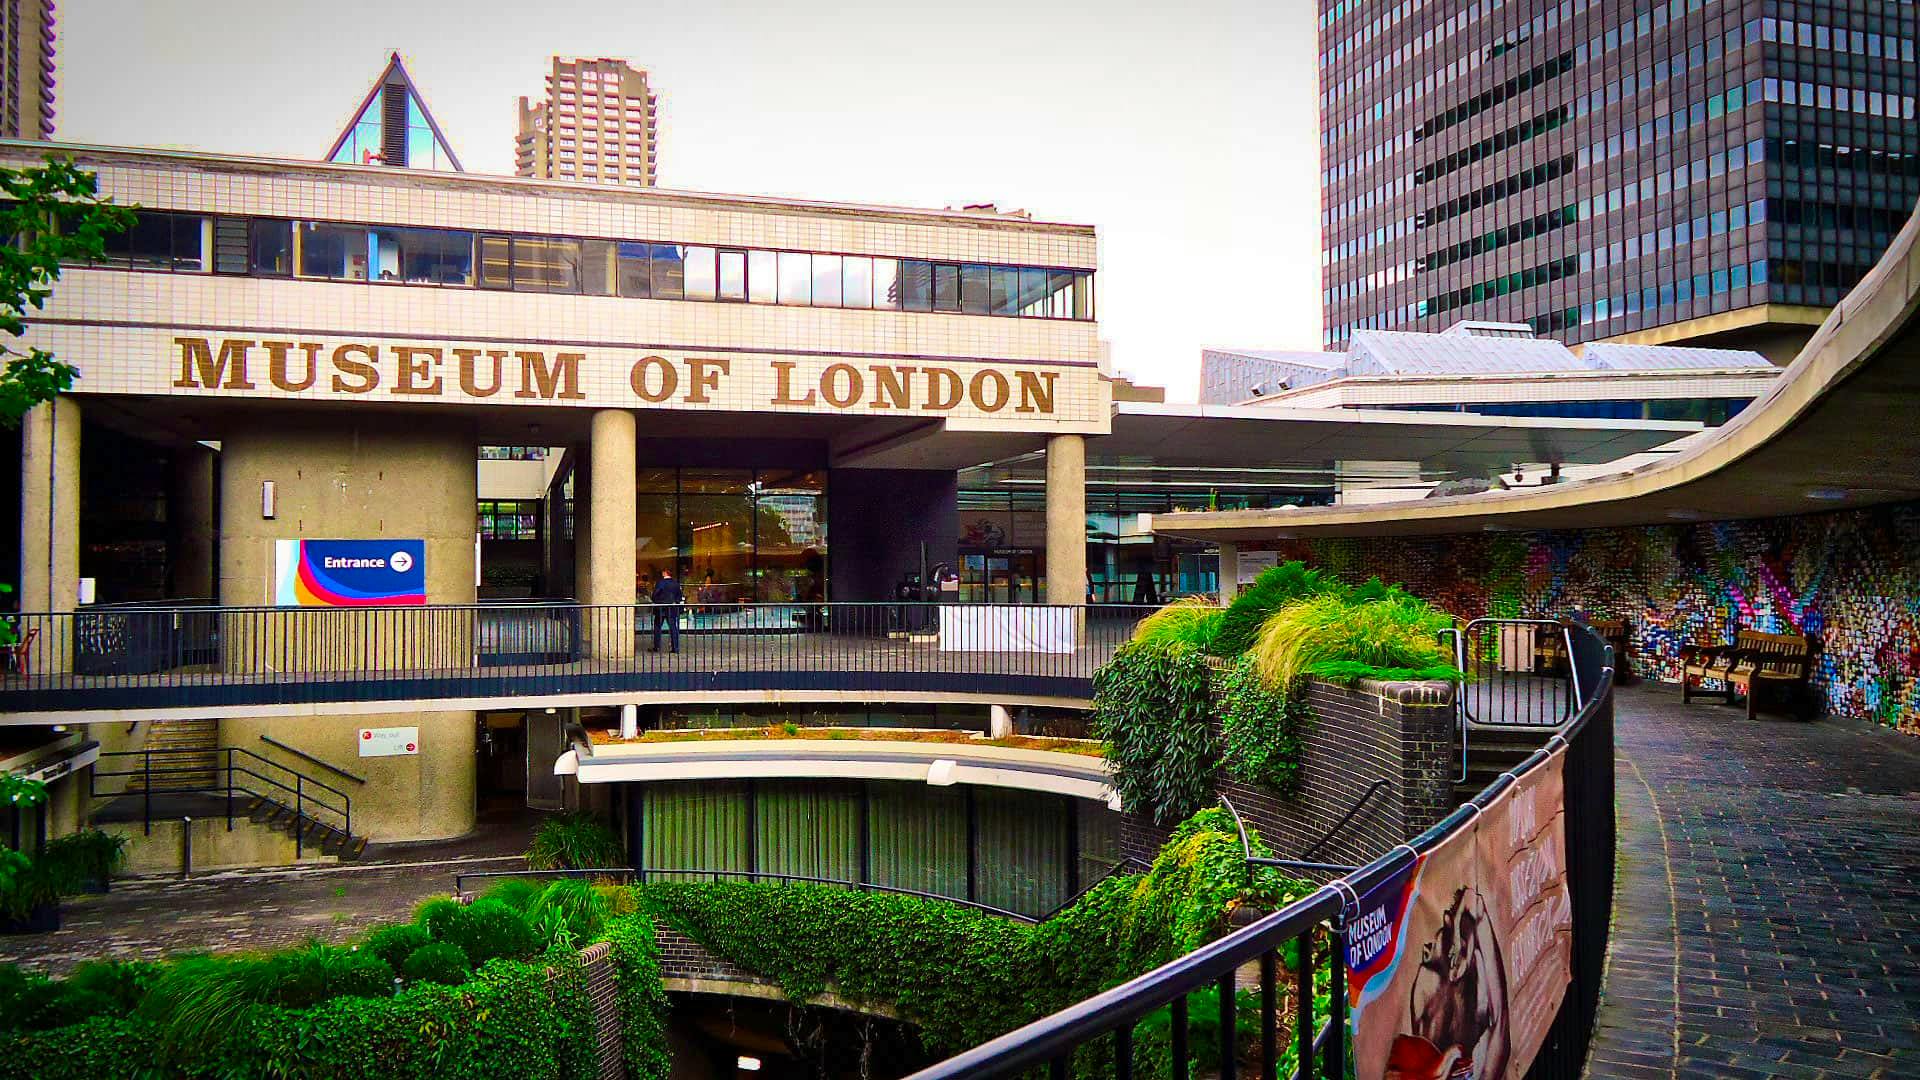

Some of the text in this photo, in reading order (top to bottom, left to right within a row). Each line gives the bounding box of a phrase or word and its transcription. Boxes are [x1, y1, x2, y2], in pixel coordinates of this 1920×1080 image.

[173, 336, 1060, 414] MUSEUM OF LONDON
[324, 556, 385, 569] Entrance
[1348, 904, 1387, 946] MUSEUM
[1350, 921, 1393, 969] OF LONDON
